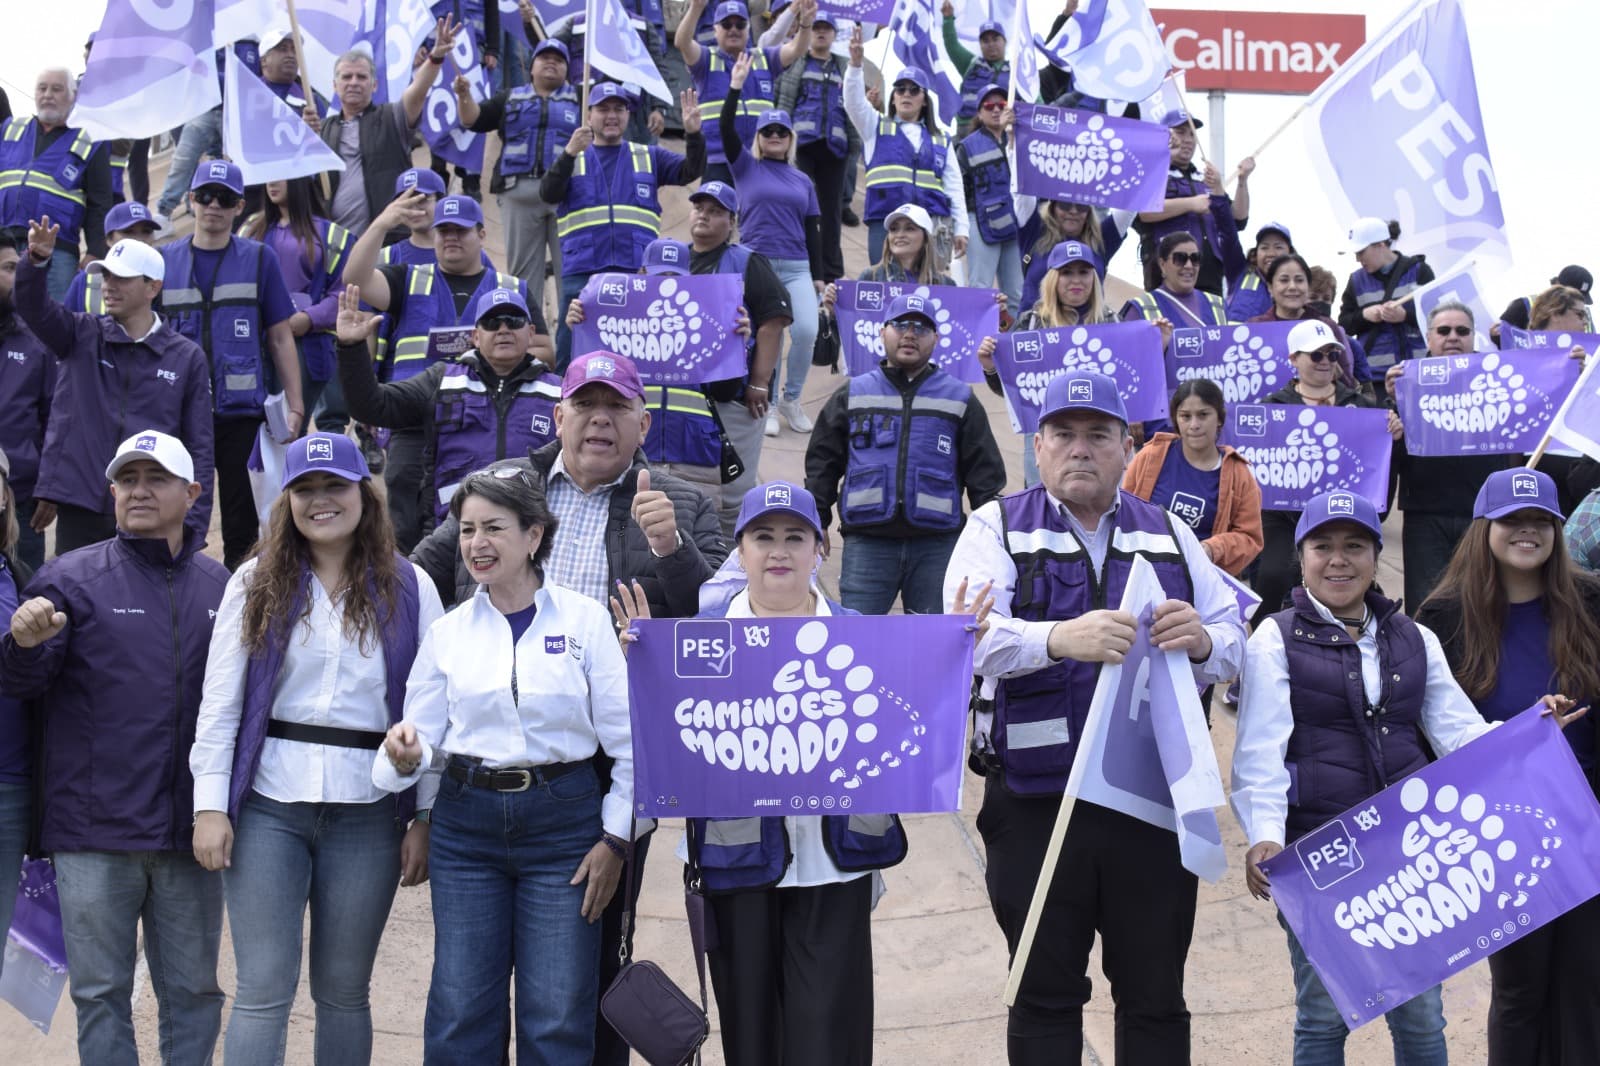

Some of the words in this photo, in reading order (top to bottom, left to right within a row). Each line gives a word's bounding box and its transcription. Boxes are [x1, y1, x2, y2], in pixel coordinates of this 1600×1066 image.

[1163, 27, 1344, 75] Calimax
[1035, 113, 1055, 126] PES
[1075, 130, 1103, 145] EL
[1371, 50, 1498, 217] PES
[1087, 146, 1110, 160] ES
[1028, 155, 1109, 184] MORADO
[602, 284, 624, 296] PES
[859, 291, 880, 302] PES
[646, 300, 677, 318] EL
[661, 315, 685, 333] ES
[600, 330, 687, 362] MORADO
[1016, 340, 1038, 352] PES
[1177, 337, 1199, 348] PES
[7, 351, 25, 360] PES
[1062, 347, 1092, 366] EL
[1222, 345, 1252, 362] EL
[157, 369, 176, 380] PES
[589, 361, 612, 371] PES
[1237, 359, 1260, 376] ES
[1423, 365, 1445, 376] PES
[1072, 386, 1089, 394] PES
[1470, 373, 1501, 391] EL
[1485, 388, 1510, 403] ES
[1239, 414, 1262, 426] PES
[1422, 401, 1511, 433] MORADO
[1285, 428, 1316, 446] EL
[309, 443, 330, 453] PES
[1299, 445, 1323, 461] ES
[1249, 460, 1324, 489] ORADO
[1515, 480, 1536, 489] PES
[768, 490, 788, 499] PES
[1174, 502, 1199, 518] PES
[546, 641, 564, 649] PES
[683, 638, 724, 658] PES
[772, 659, 831, 693] EL
[800, 690, 847, 720] ES
[680, 718, 848, 775] MORADO
[1401, 814, 1452, 857] EL
[1307, 837, 1349, 871] PES
[1434, 828, 1478, 865] ES
[1350, 850, 1495, 950] MORADO
